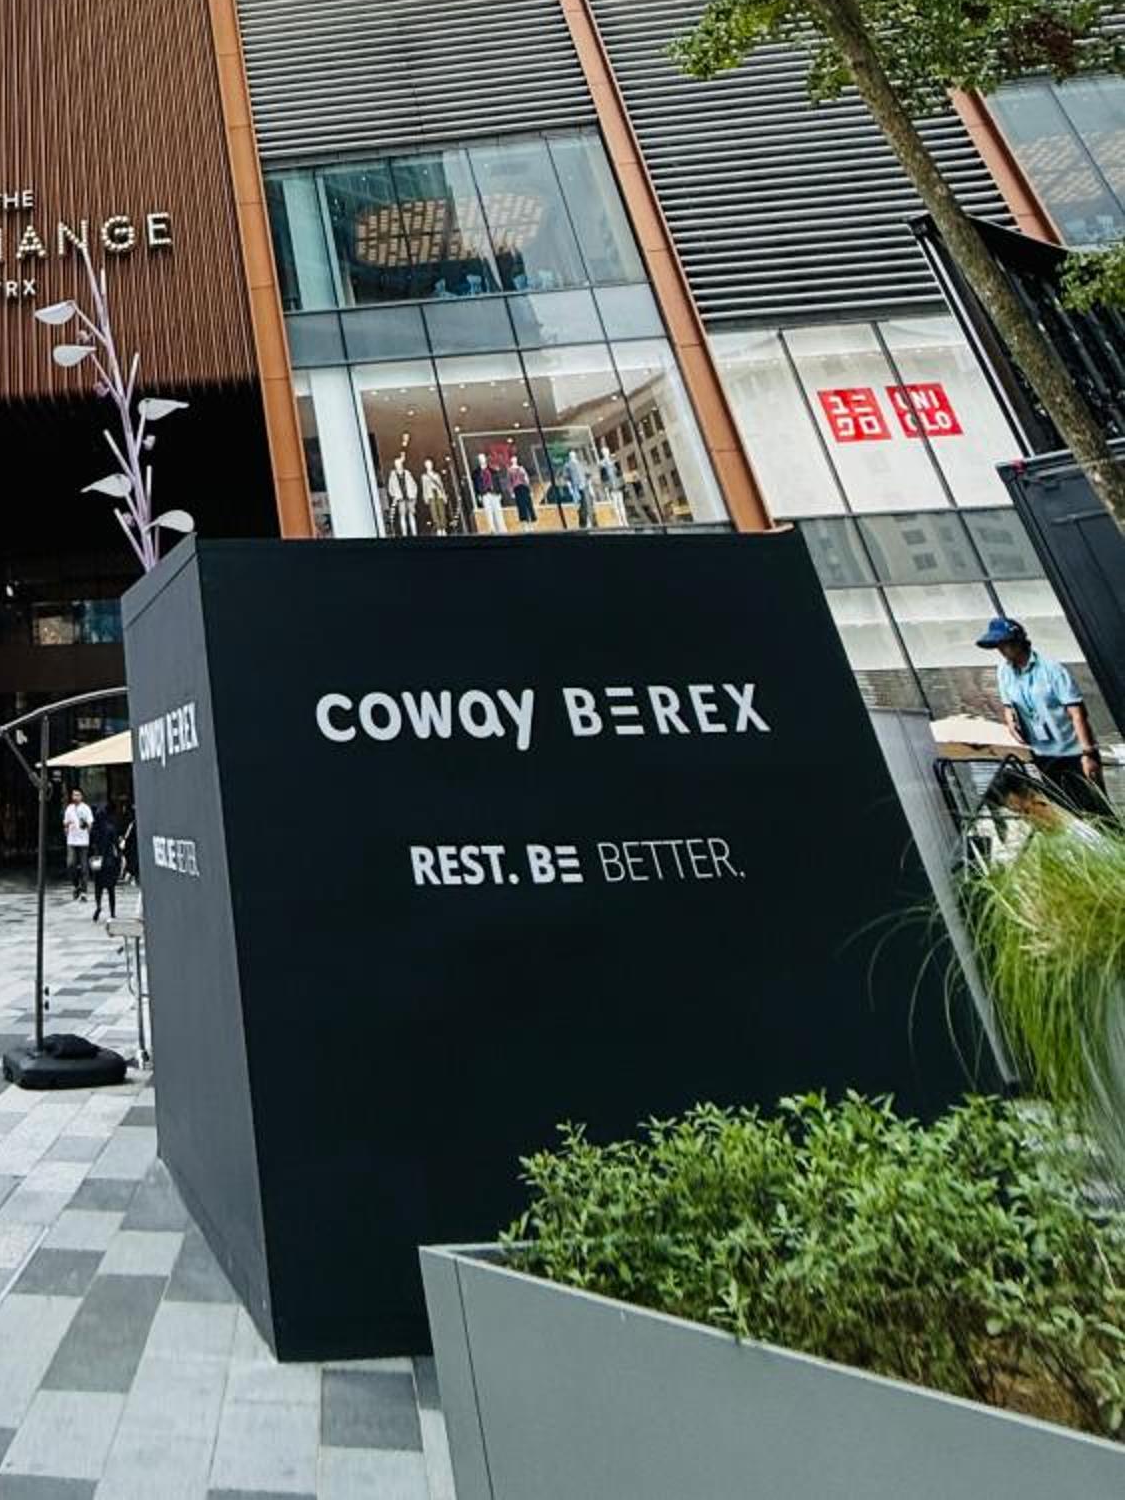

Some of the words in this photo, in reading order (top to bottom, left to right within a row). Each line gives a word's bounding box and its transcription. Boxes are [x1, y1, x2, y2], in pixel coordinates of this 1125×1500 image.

[562, 683, 771, 737] BEREX
[410, 845, 519, 885] REST.
[526, 844, 584, 884] BE
[597, 838, 746, 882] BETTER.
